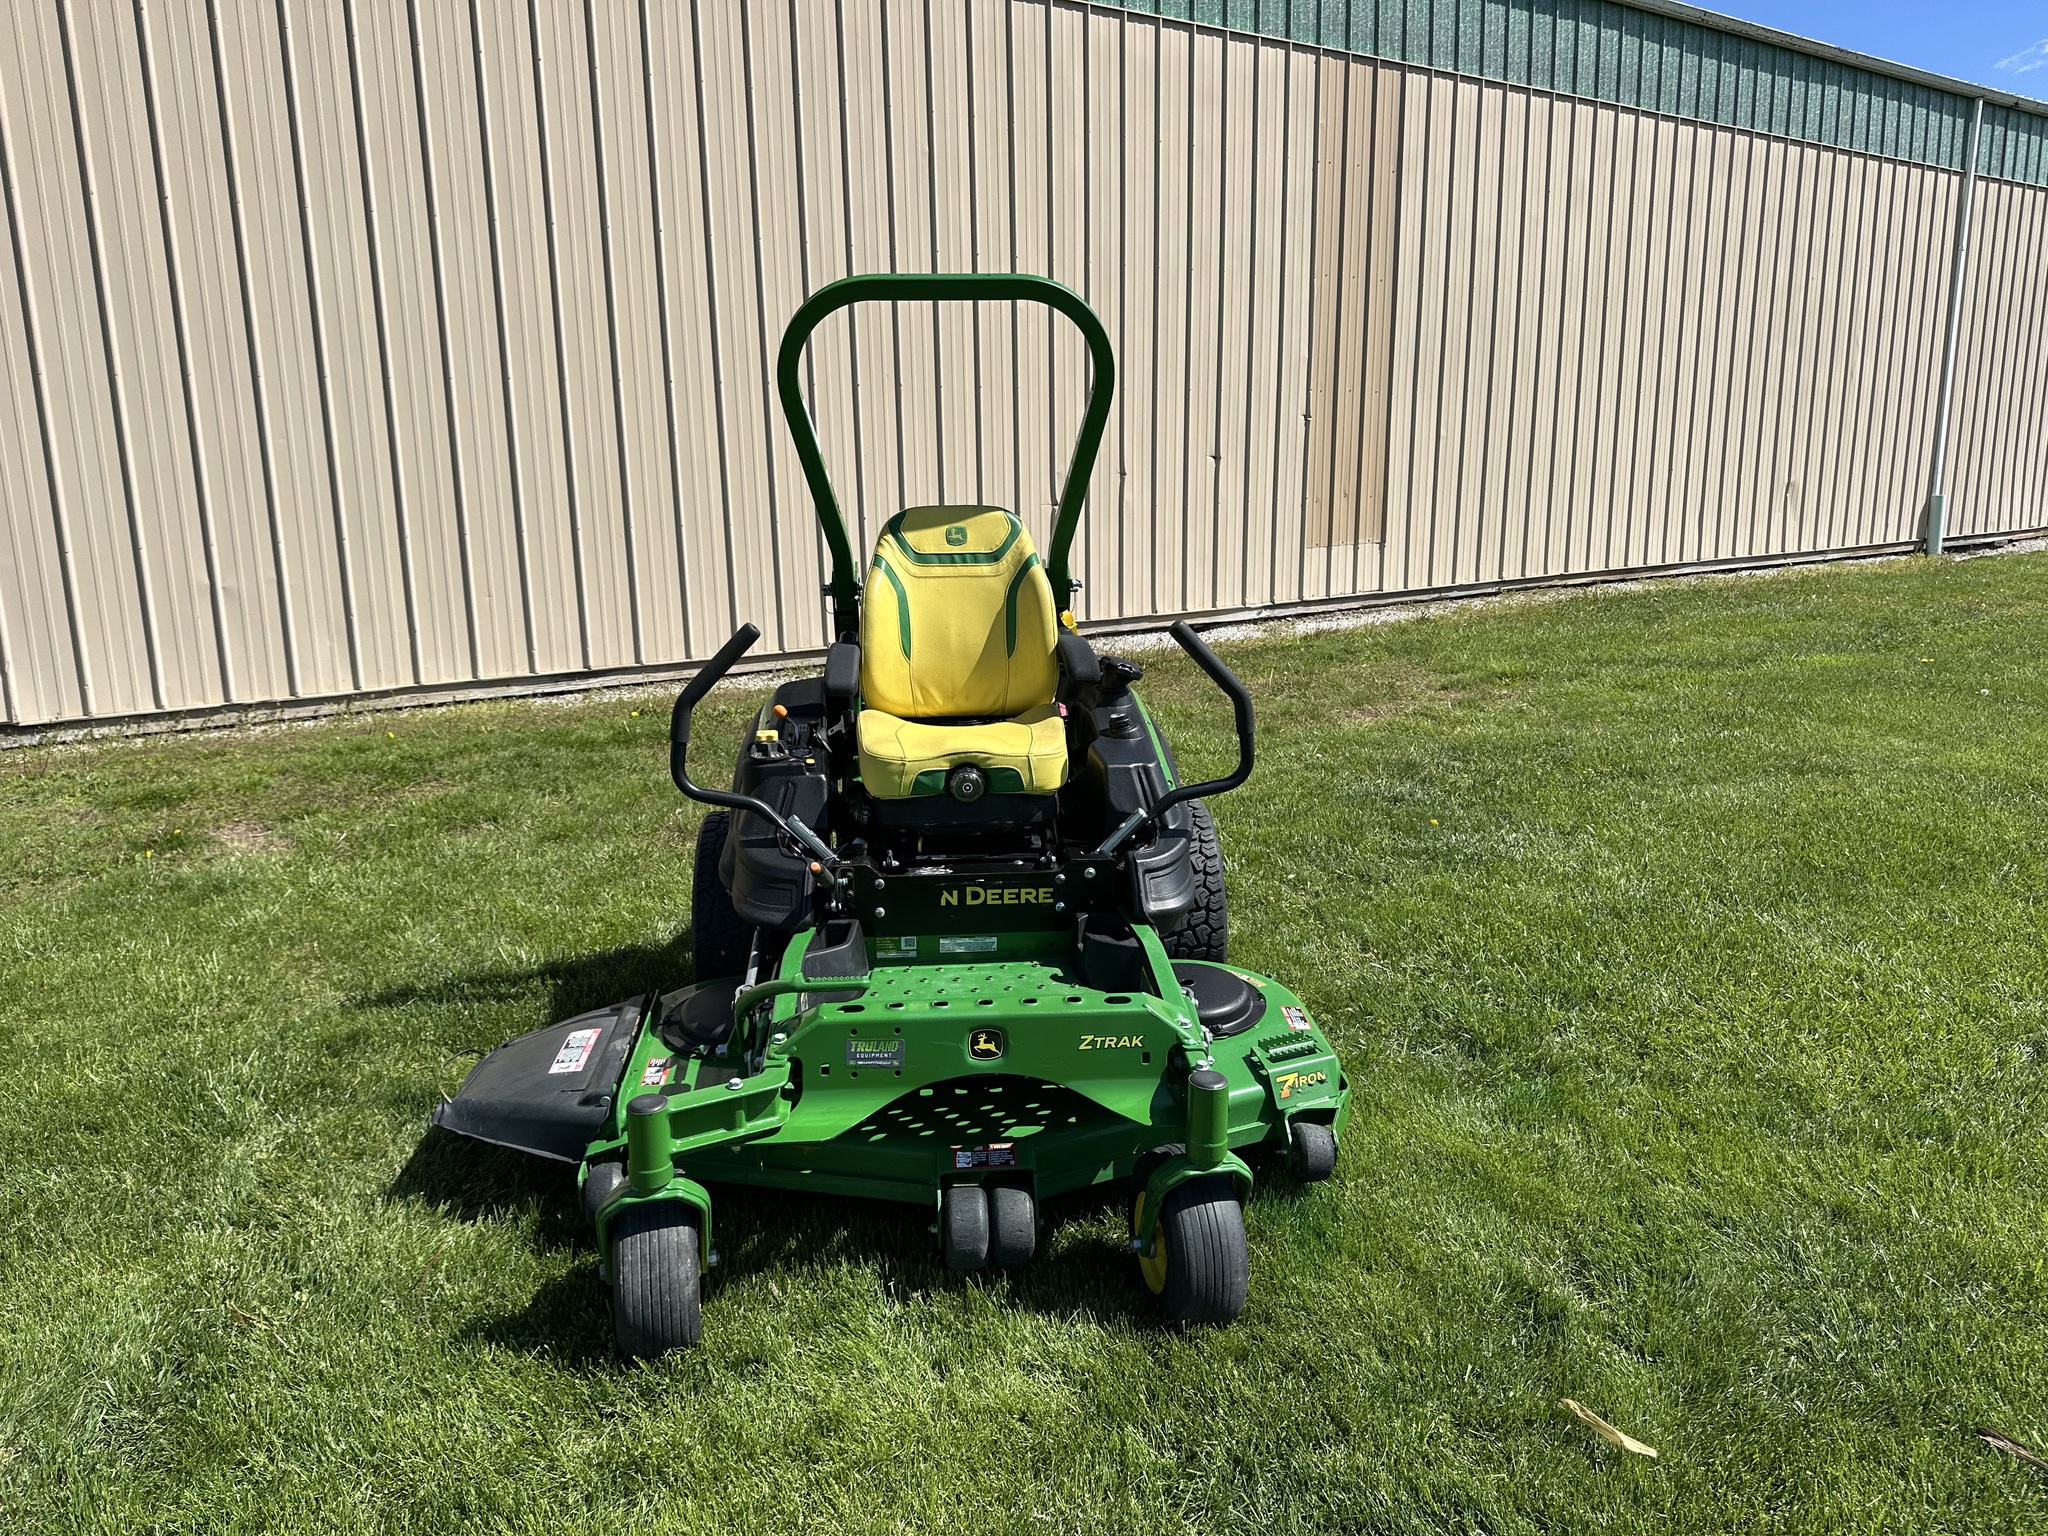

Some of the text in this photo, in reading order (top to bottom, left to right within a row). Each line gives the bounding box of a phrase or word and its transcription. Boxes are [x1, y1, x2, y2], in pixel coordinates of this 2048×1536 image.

[966, 886, 1054, 906] DEERE
[850, 1041, 899, 1052] TRULAND
[1078, 1034, 1145, 1050] ZTRAK
